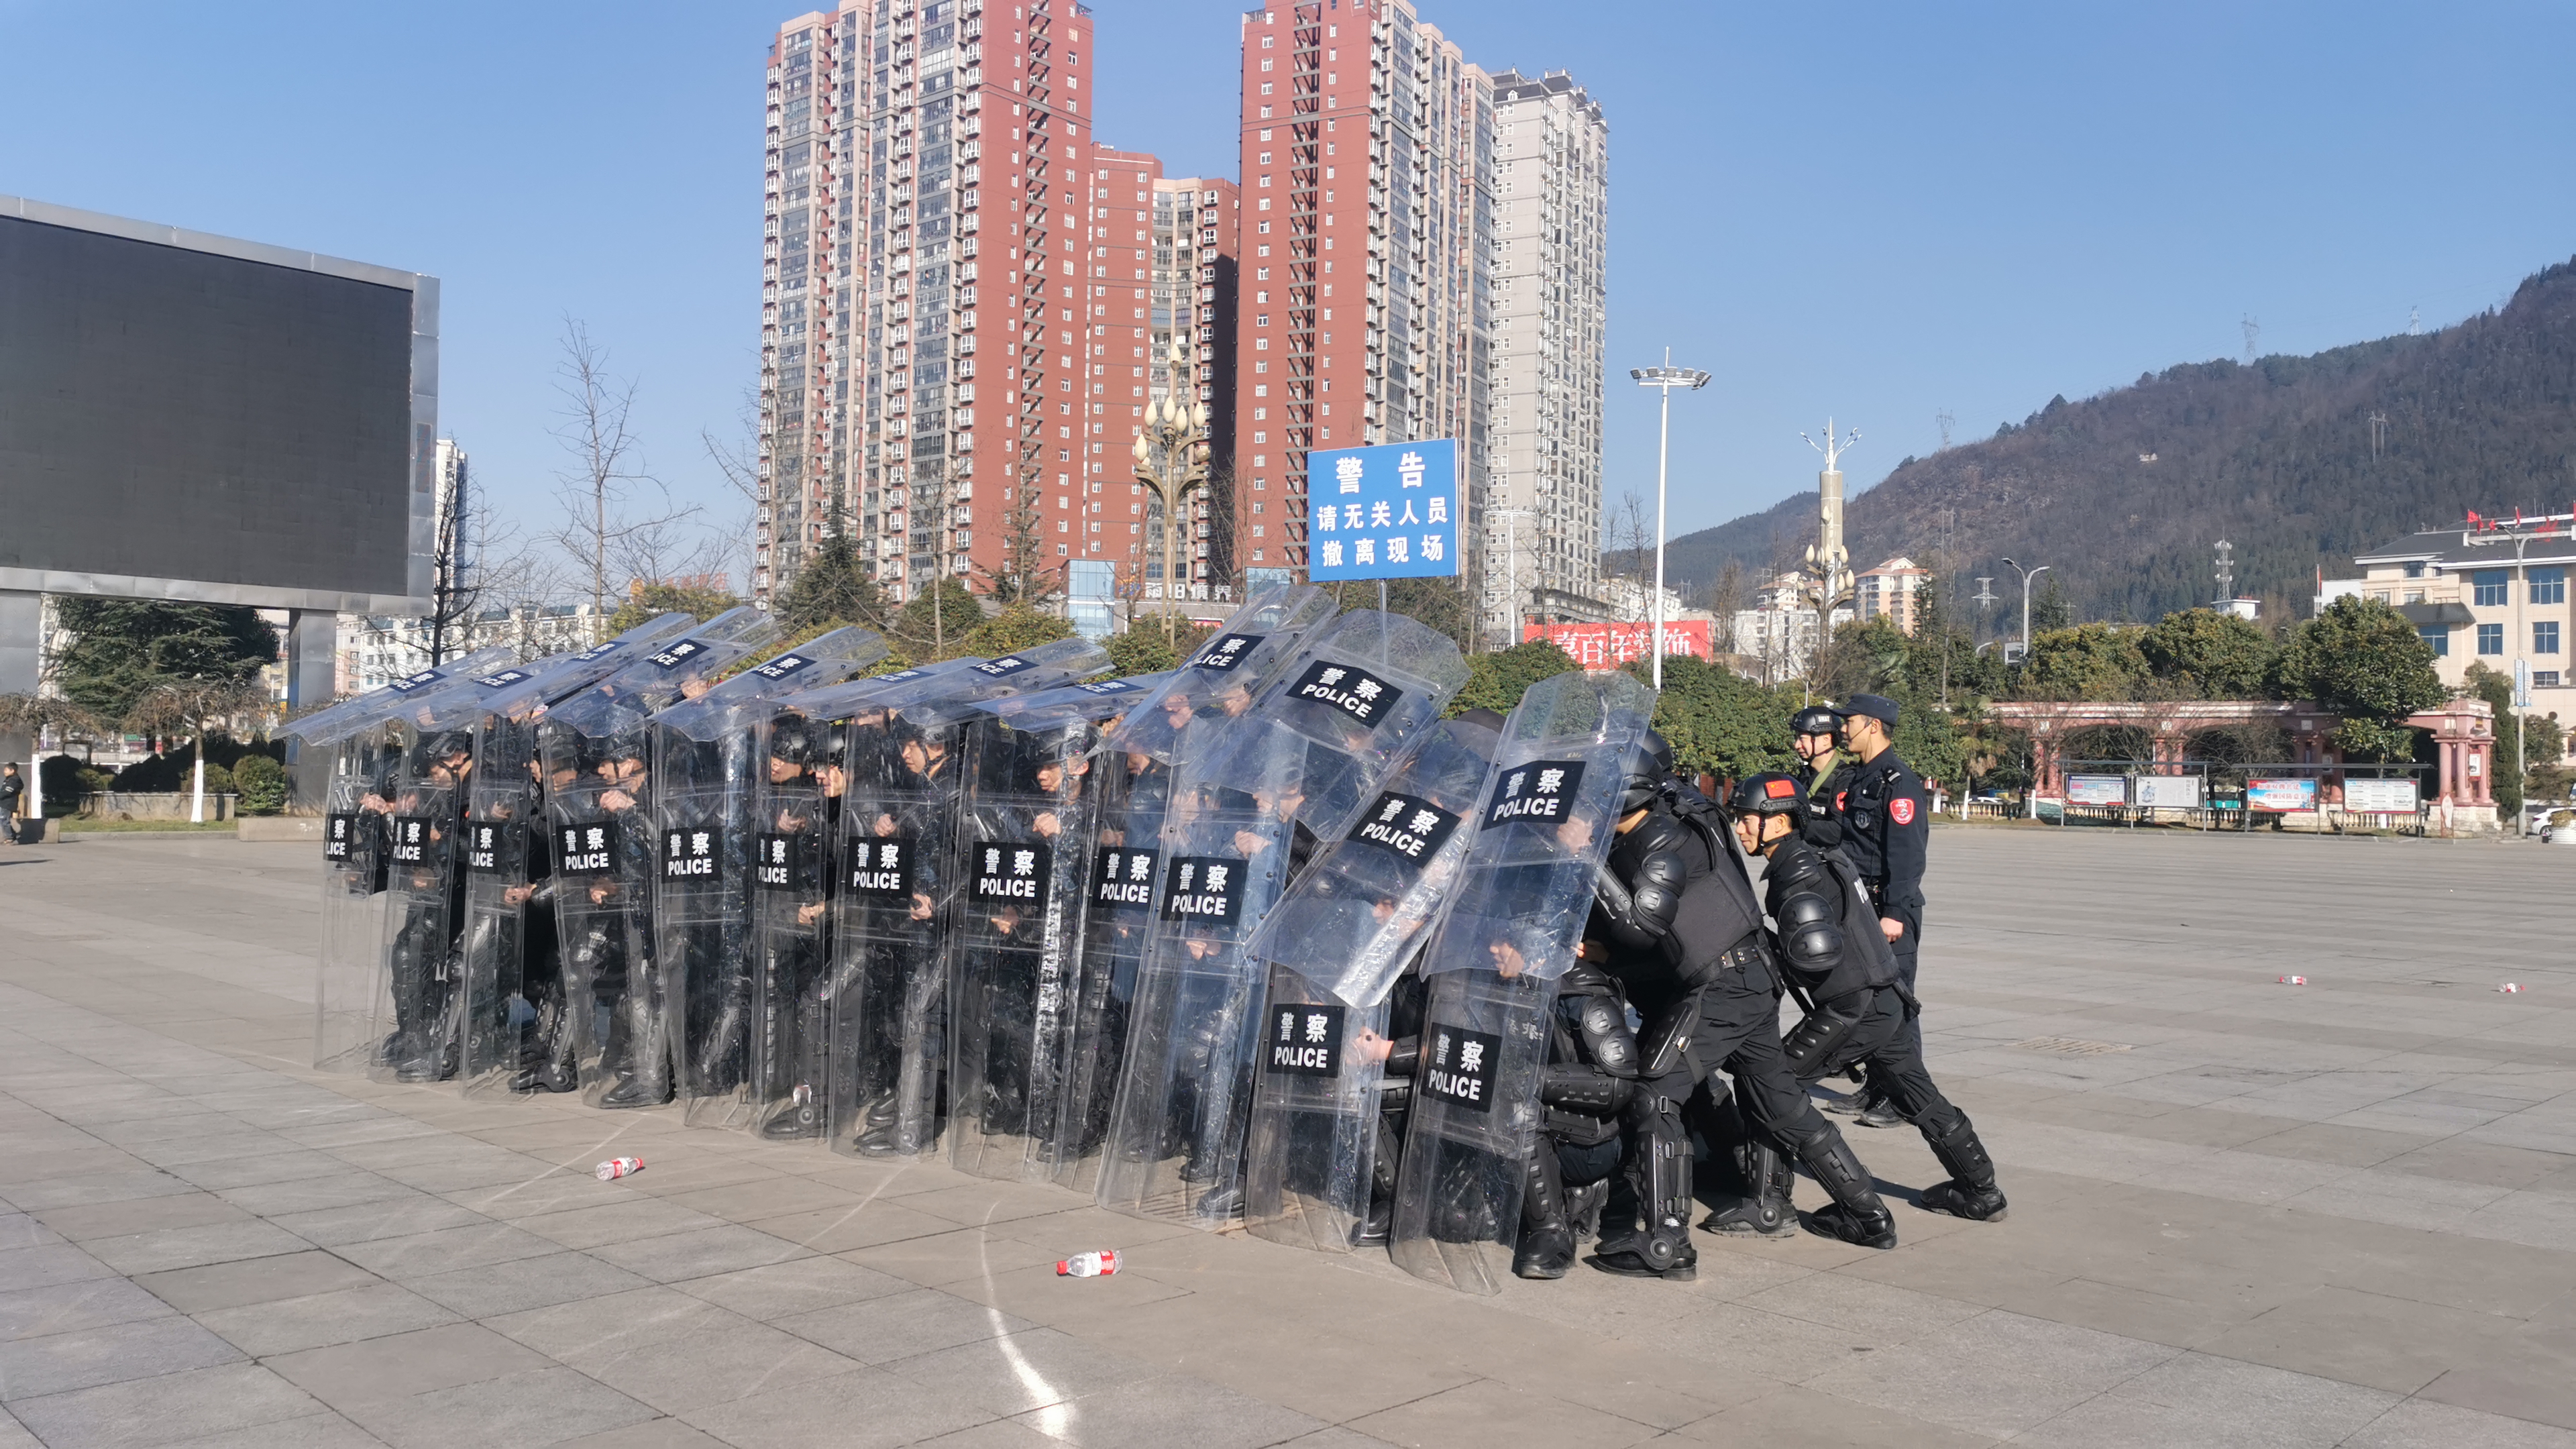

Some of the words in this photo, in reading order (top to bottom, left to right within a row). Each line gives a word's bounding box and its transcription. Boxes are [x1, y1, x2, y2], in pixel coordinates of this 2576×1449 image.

[1336, 451, 1426, 494] 警告
[1317, 496, 1448, 531] 请无关人员
[1322, 535, 1443, 567] 撤离现场
[1318, 667, 1383, 702] 警察
[1301, 684, 1372, 718] POLICE
[1505, 768, 1564, 799] 警察
[1379, 799, 1440, 836] 警察
[1493, 798, 1559, 821] POLICE
[396, 821, 421, 843] 察
[565, 827, 604, 852] 警察
[670, 832, 710, 857] 警察
[1360, 822, 1426, 857] POLICE
[393, 845, 421, 860] PLICE
[565, 853, 609, 870] POLICE
[857, 843, 899, 869] 警察
[985, 848, 1035, 875] 警察
[668, 858, 712, 876] POLICE
[853, 871, 900, 890] POLICE
[1107, 853, 1150, 881] 警察
[1179, 863, 1228, 892] 警察
[979, 877, 1036, 898] POLICE
[1100, 883, 1149, 904] POLICE
[1171, 895, 1227, 916] POLICE
[1281, 1012, 1328, 1042] 警察
[1275, 1046, 1328, 1068] POLICE
[1436, 1033, 1484, 1072] 警察
[1429, 1069, 1482, 1100] POLICE
